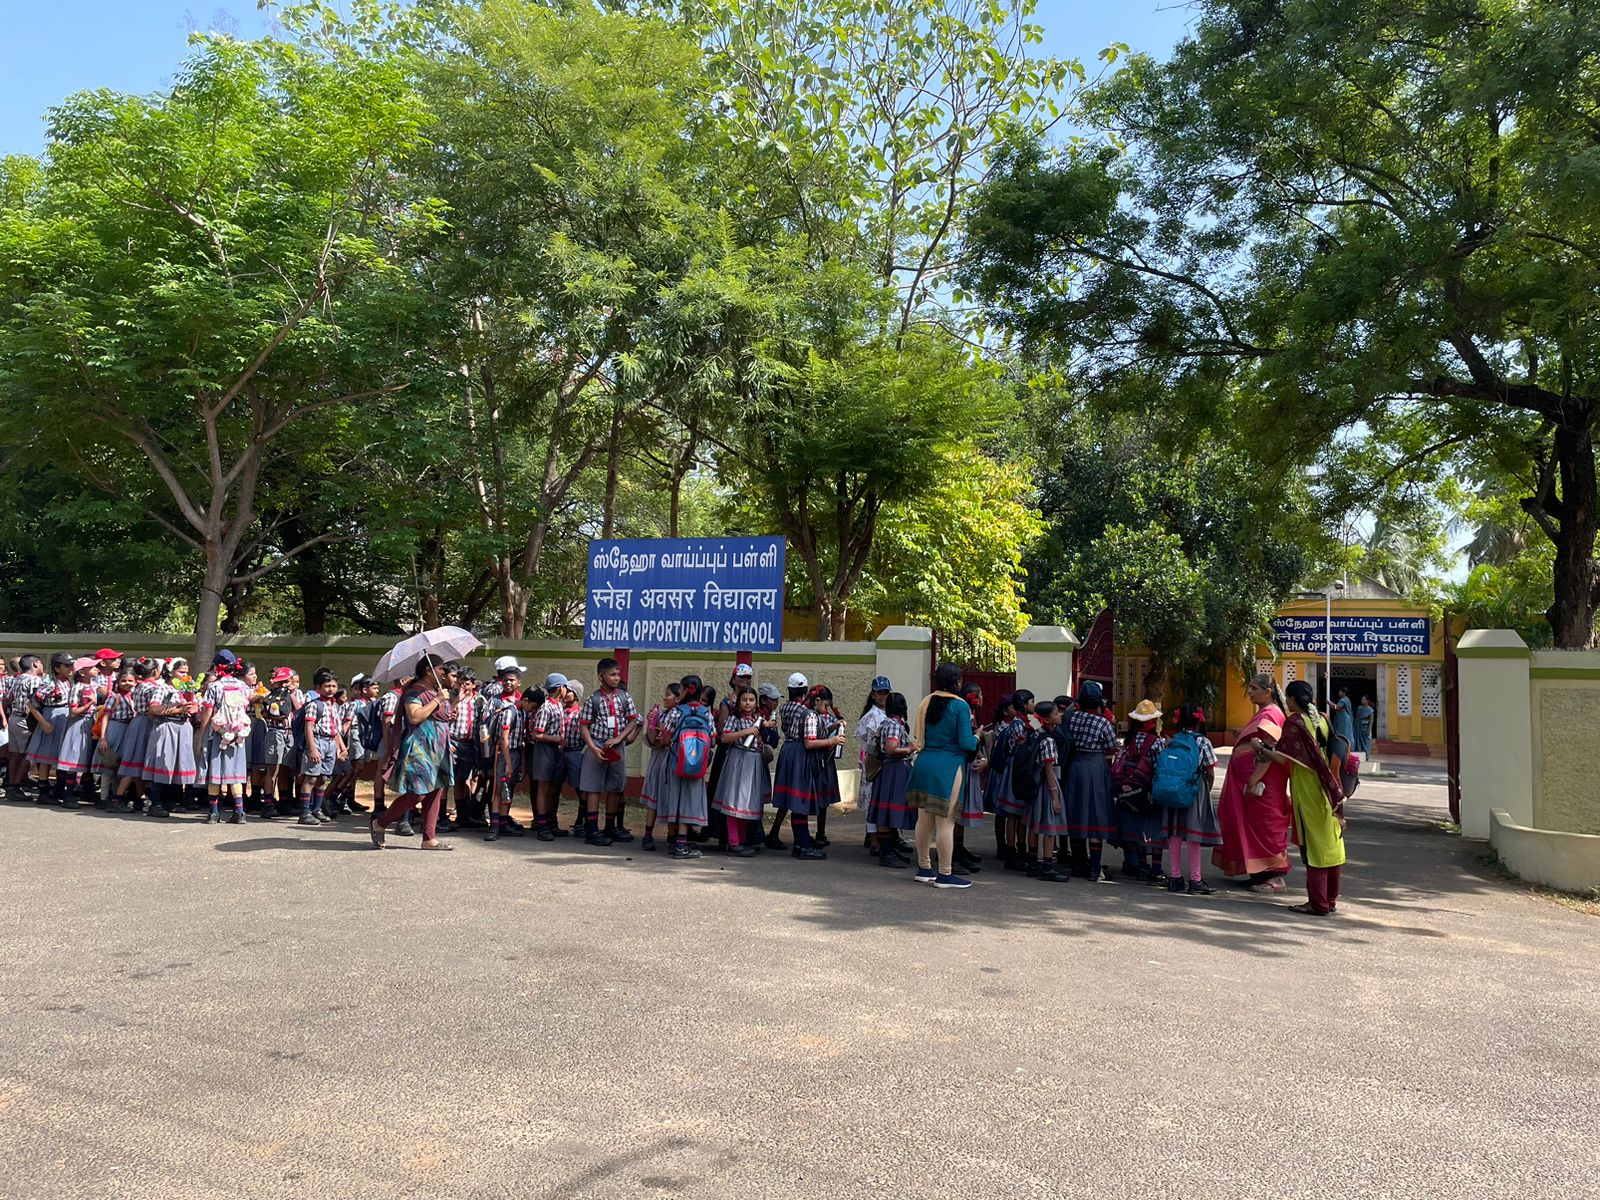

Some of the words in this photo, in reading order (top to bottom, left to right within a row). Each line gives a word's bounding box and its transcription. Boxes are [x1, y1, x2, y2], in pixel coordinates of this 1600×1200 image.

[593, 545, 656, 576] ஸ்நேஹா
[661, 545, 728, 574] வாய்ப்புப்
[732, 543, 777, 569] பள்ளி
[592, 581, 633, 611] स्नेहा
[640, 588, 697, 610] अवसर
[703, 580, 778, 610] विद्यालय
[590, 619, 629, 641] SNEHA
[633, 620, 720, 643] OPPORTUNITY
[723, 621, 775, 645] SCHOOL
[1388, 618, 1425, 629] பள்ளி
[1363, 631, 1425, 643] विद्यालय
[1278, 642, 1305, 651] NEHA
[1382, 643, 1425, 654] SCHOOL
